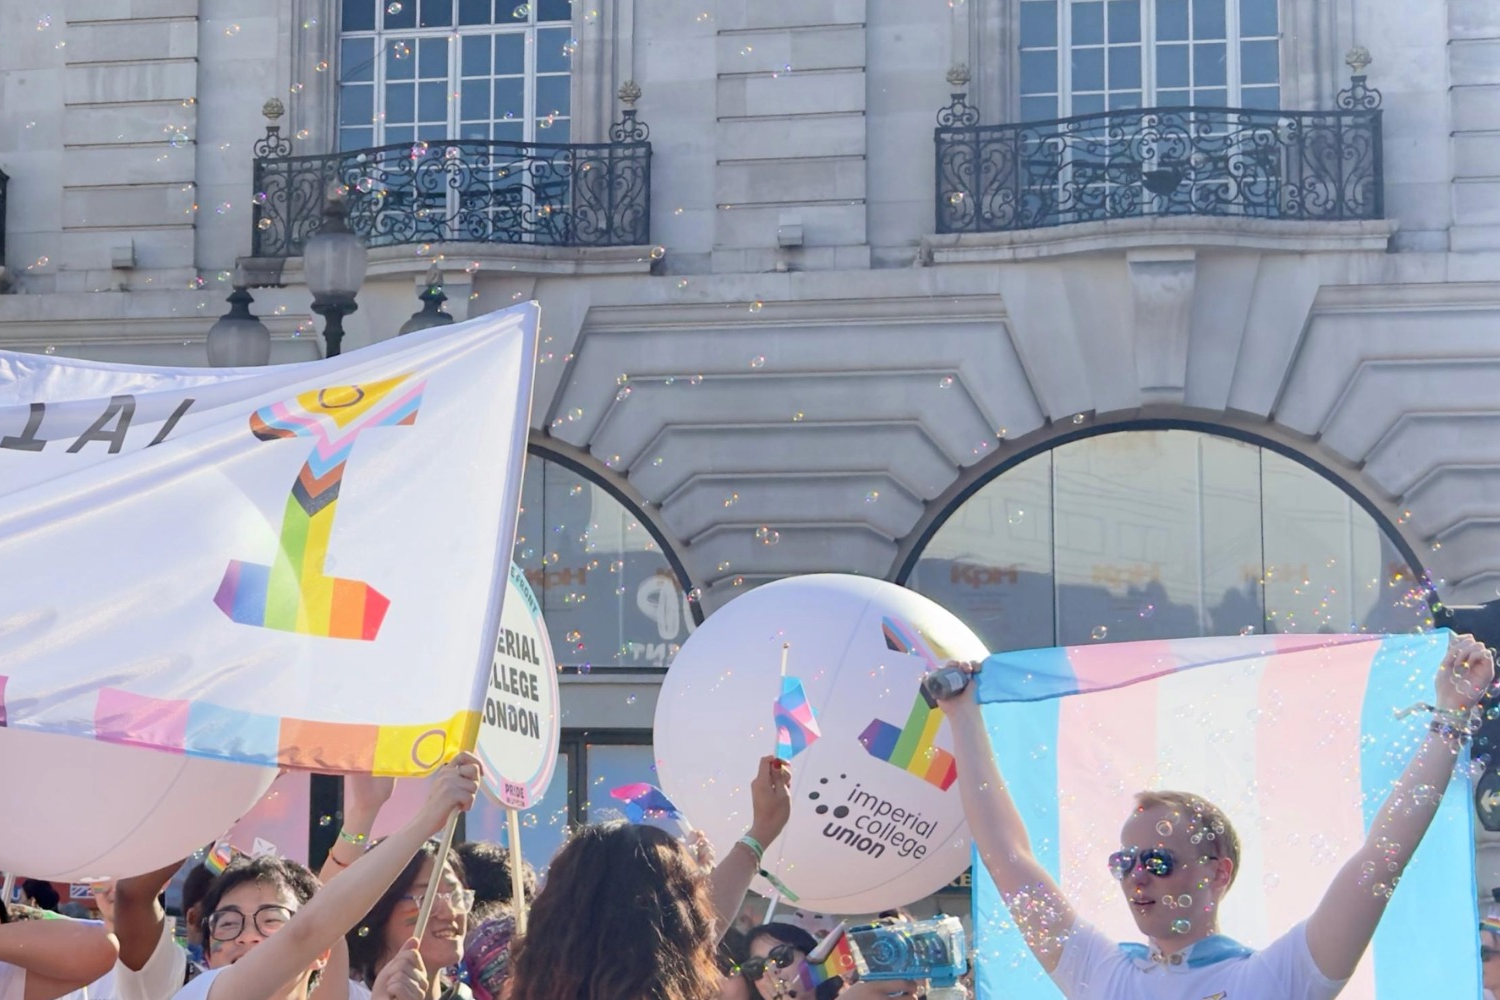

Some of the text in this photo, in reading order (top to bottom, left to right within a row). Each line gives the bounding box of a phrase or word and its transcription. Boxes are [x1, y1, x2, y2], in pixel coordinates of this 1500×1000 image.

[497, 629, 540, 666] ERIAL
[490, 664, 540, 702] LLEGE
[847, 783, 938, 840] imperial
[822, 821, 886, 859] union
[854, 813, 928, 860] college
